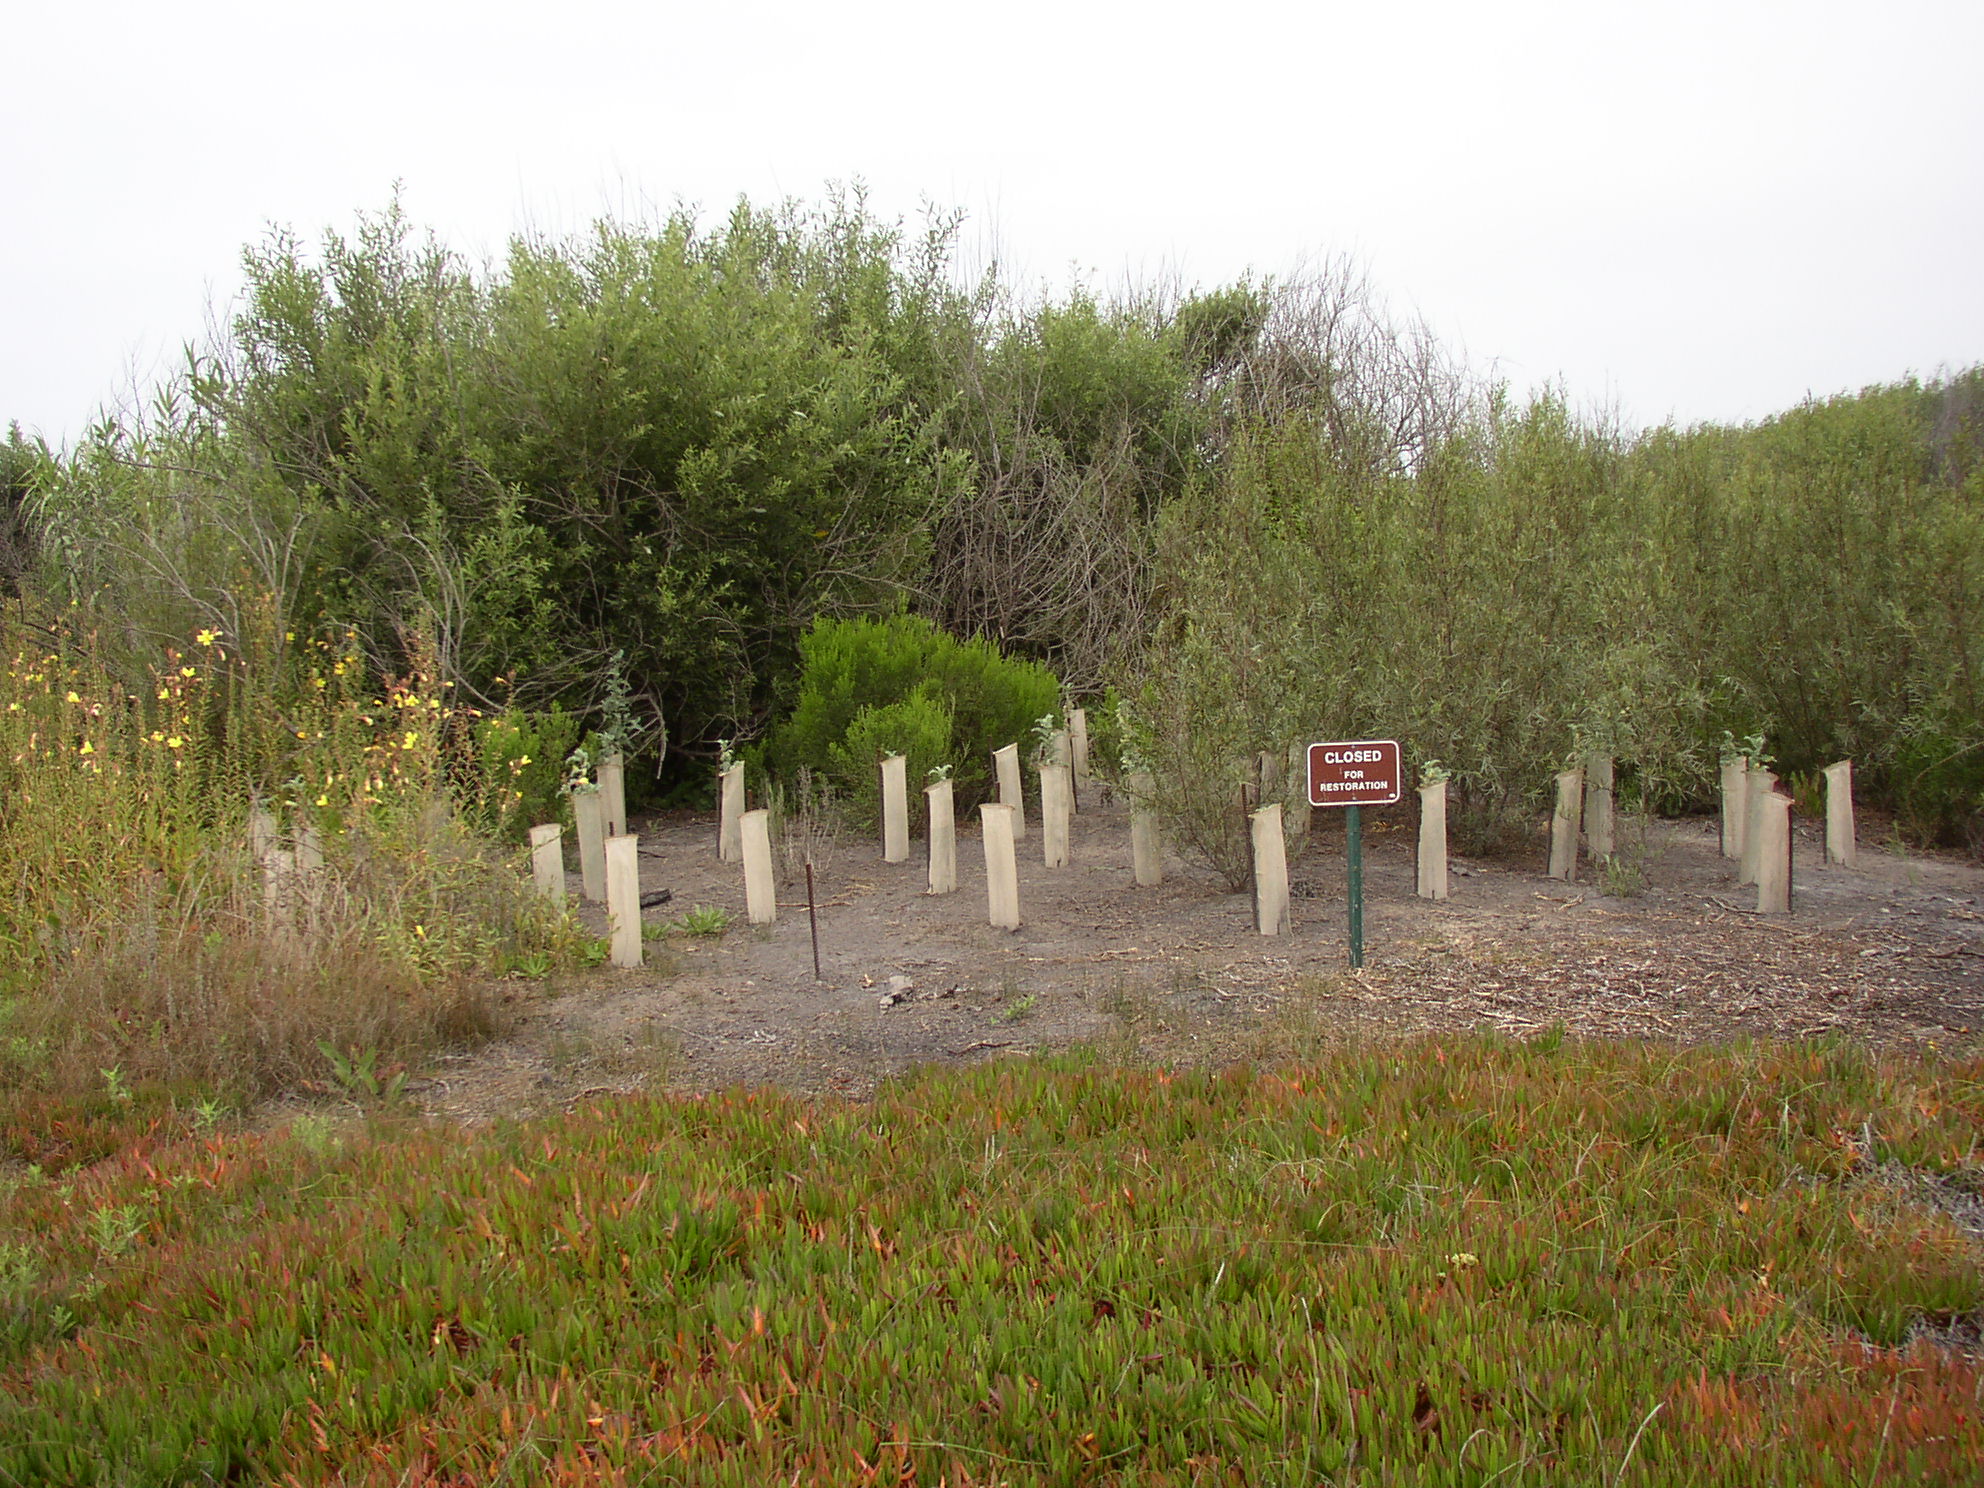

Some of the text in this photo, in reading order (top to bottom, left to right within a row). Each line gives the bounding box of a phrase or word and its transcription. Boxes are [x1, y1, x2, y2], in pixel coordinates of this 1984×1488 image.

[1325, 750, 1382, 764] CLOSED
[1343, 770, 1364, 779] FOR
[1320, 781, 1388, 792] RESTORATION
